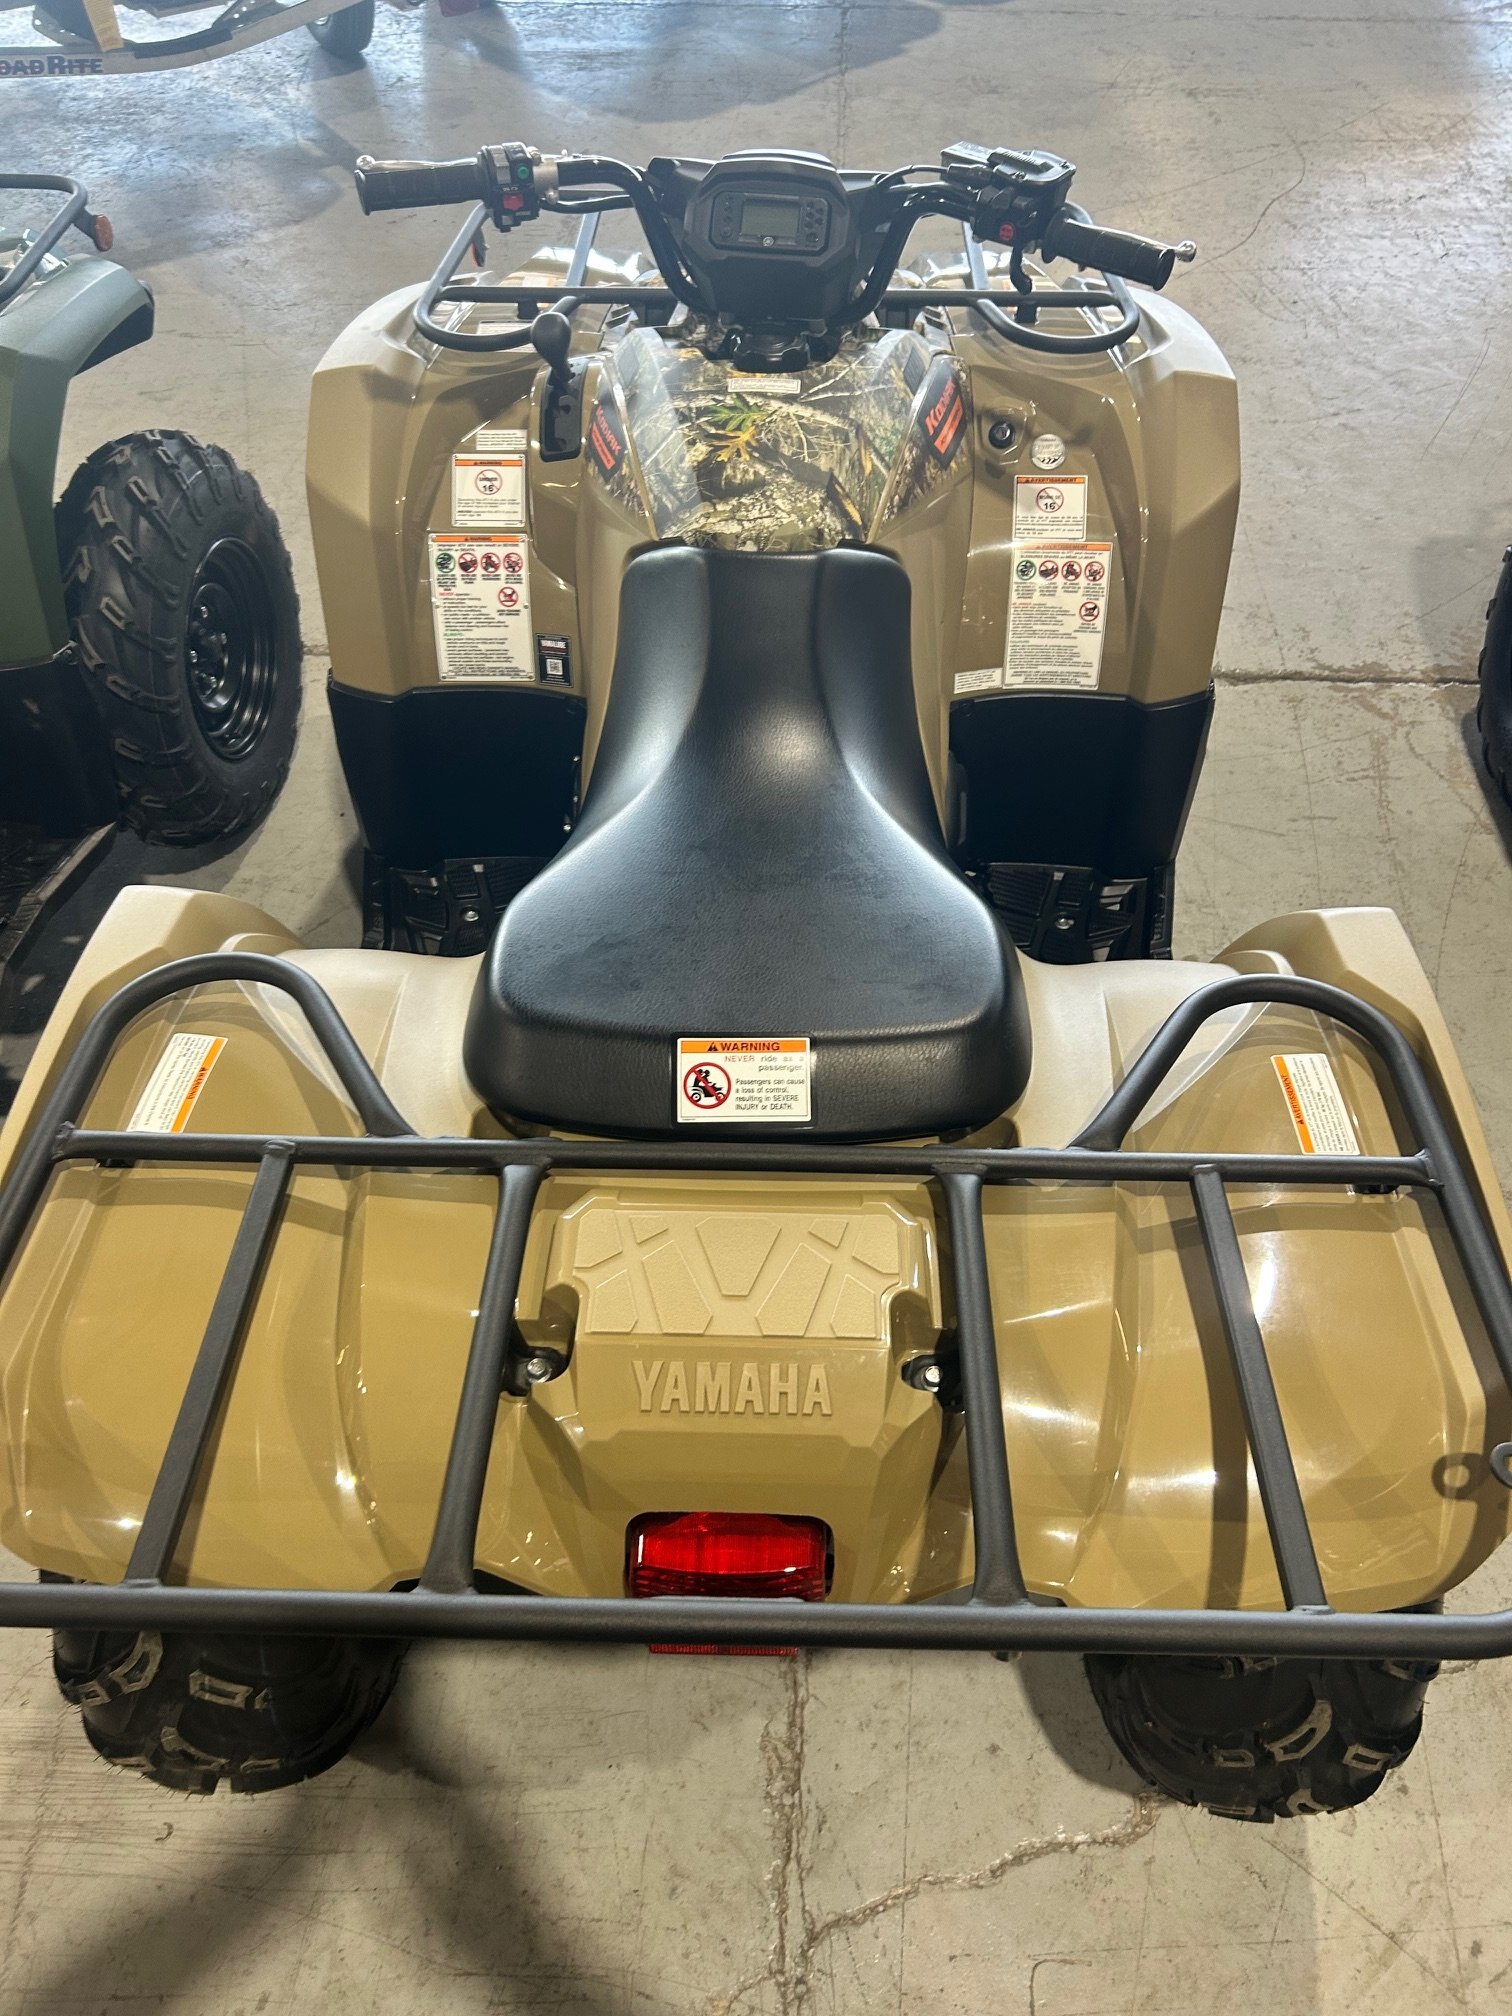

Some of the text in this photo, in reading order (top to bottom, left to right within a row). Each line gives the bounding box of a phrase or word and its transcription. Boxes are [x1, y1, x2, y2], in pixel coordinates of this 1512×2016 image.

[1043, 502, 1056, 511] 16
[721, 1042, 780, 1051] WARNING
[758, 1064, 804, 1072] passenger.
[735, 1095, 763, 1103] resulting
[632, 1360, 833, 1416] YAMAHA
